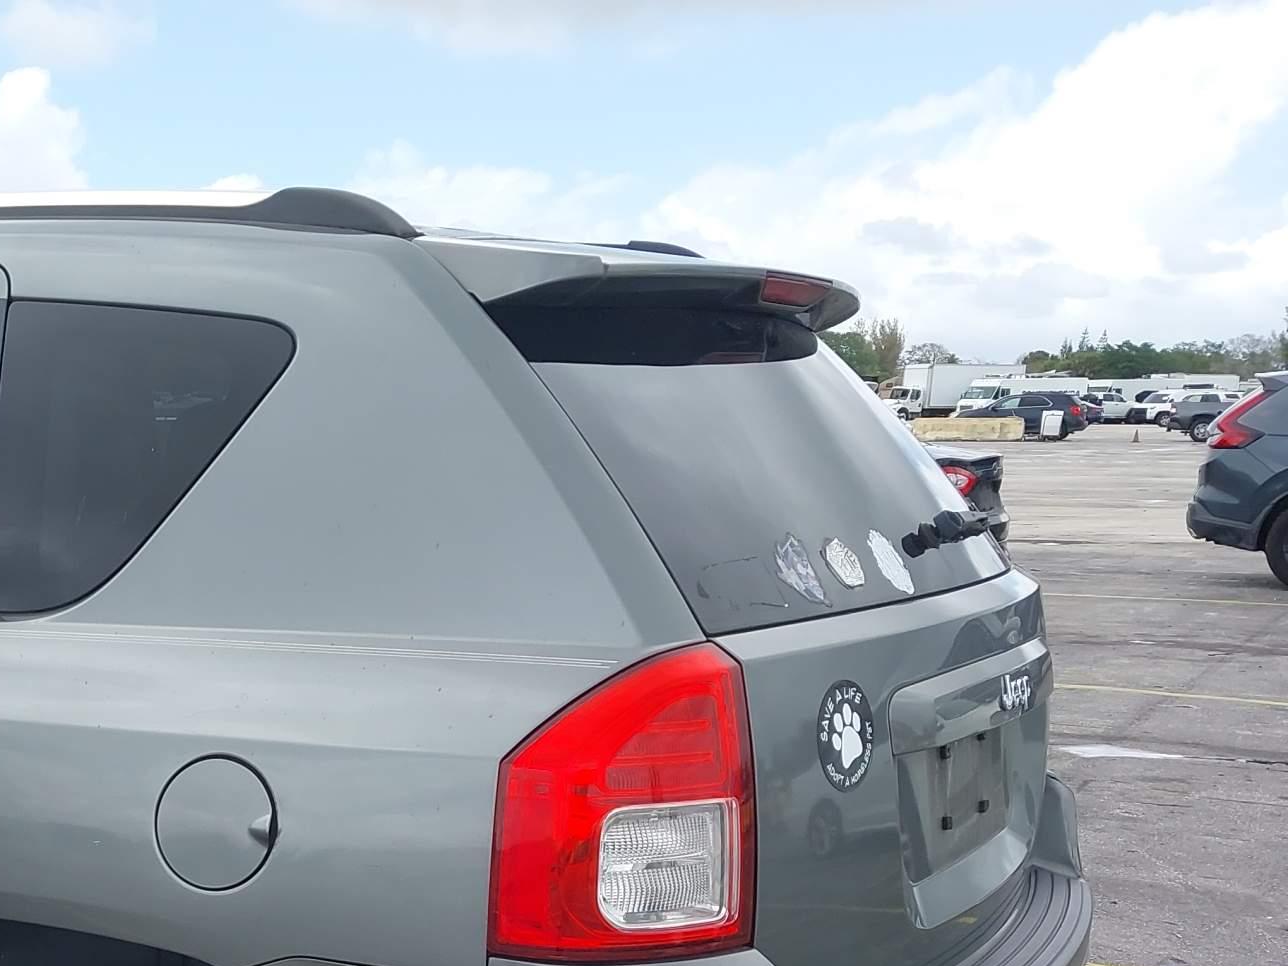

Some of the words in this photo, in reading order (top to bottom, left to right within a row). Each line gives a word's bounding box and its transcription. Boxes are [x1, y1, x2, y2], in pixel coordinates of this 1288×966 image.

[1001, 674, 1031, 710] Jeep
[820, 697, 835, 742] SAVE
[836, 690, 843, 705] A
[843, 687, 863, 704] LIFE
[826, 762, 844, 785] ADOPT
[845, 776, 850, 787] A
[851, 743, 873, 785] HOMELESS
